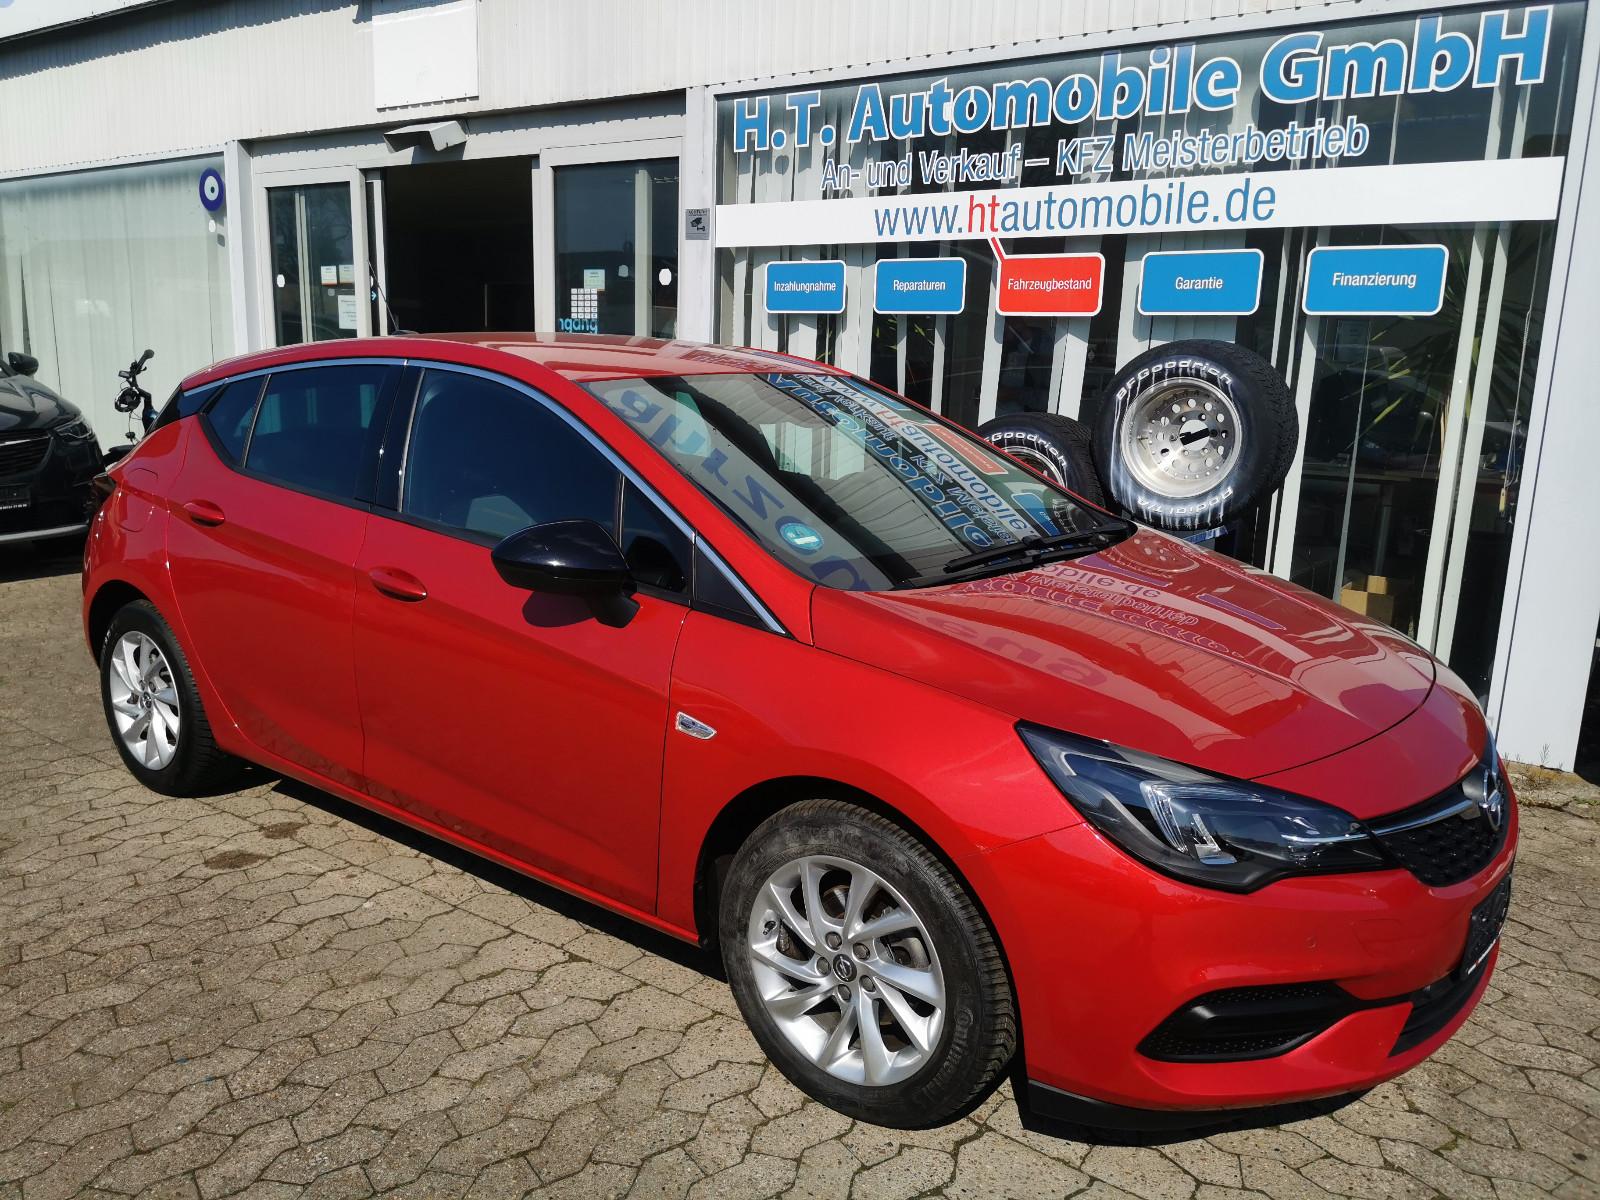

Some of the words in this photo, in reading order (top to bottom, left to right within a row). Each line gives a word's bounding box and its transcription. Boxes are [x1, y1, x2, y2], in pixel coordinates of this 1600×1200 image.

[734, 90, 836, 152] H.T.
[847, 42, 1242, 144] Automobile
[1260, 5, 1554, 104] GmbH
[821, 159, 860, 190] An-
[866, 152, 913, 188] und
[919, 143, 1021, 185] Verkauf
[1056, 136, 1113, 176] KFZ
[1123, 116, 1370, 171] Meisterbetrieb
[875, 178, 1276, 236] www.htautomobile.de
[773, 279, 837, 293] Inzahlungnahme
[893, 279, 946, 293] Reparaturen
[1007, 277, 1092, 292] Fahrzeugbestand
[1175, 276, 1223, 290] Garantie
[1332, 271, 1417, 289] Finanzierung
[1116, 360, 1233, 400] BFGoodrich
